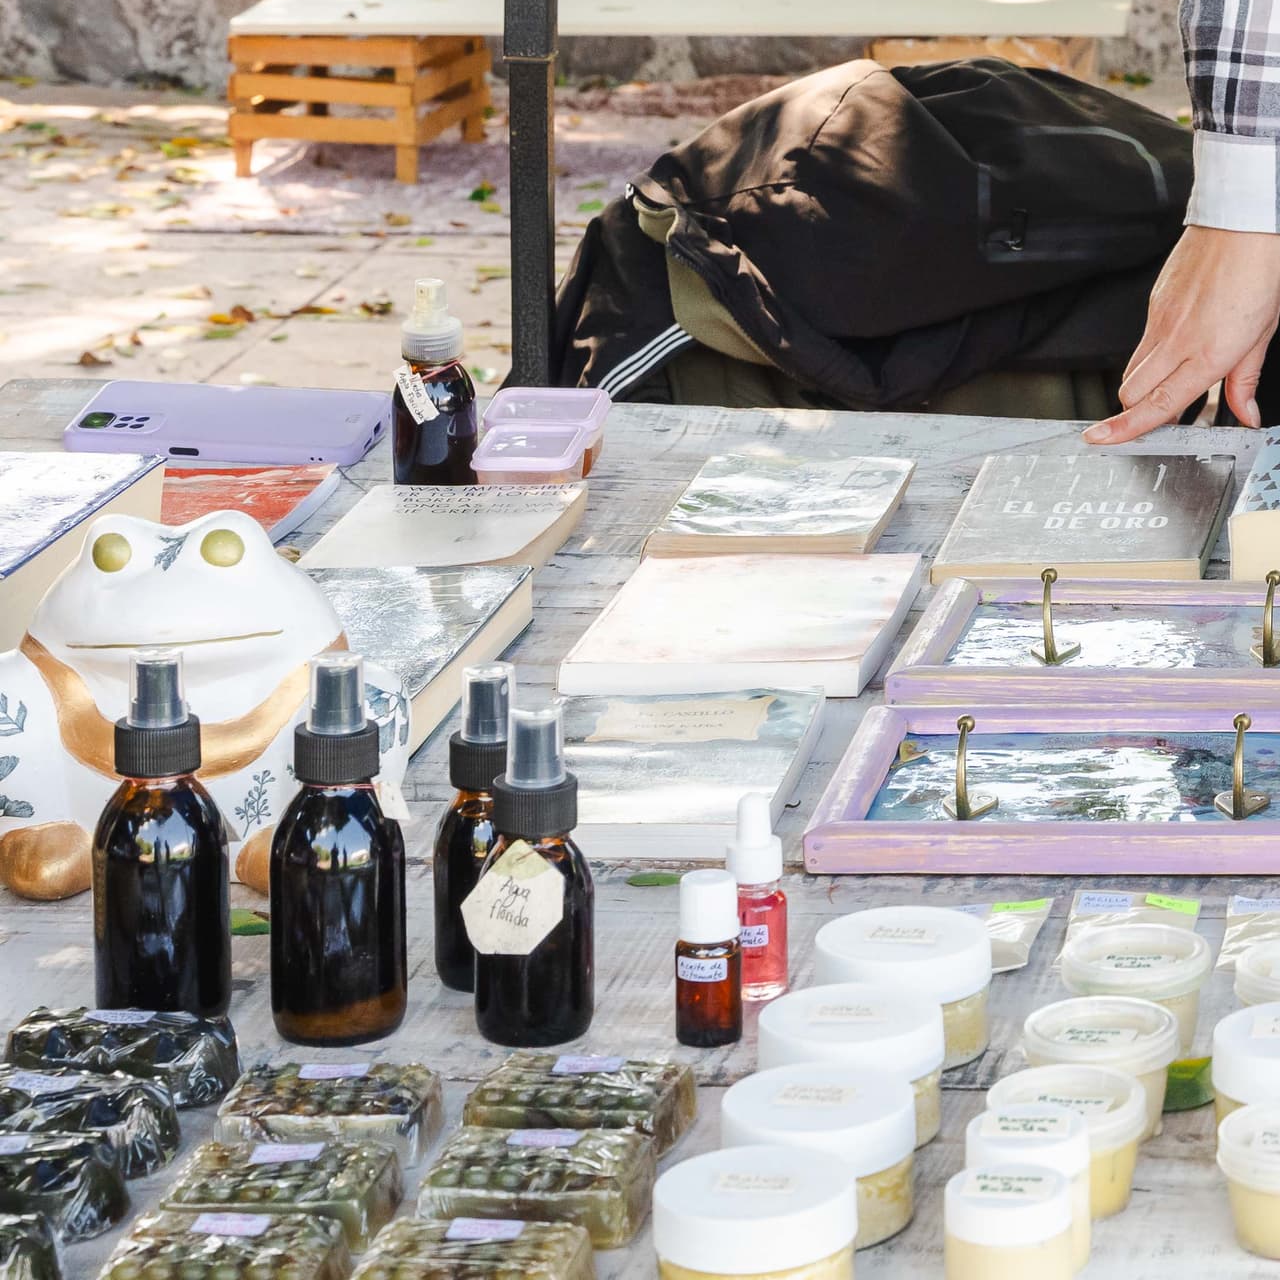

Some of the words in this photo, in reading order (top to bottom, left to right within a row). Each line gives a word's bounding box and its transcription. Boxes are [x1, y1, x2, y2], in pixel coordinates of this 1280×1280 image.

[463, 483, 579, 492] IMPOSSIBLE
[1002, 500, 1038, 514] EL
[1052, 501, 1154, 514] GALLO
[1043, 516, 1089, 530] DE
[1100, 516, 1169, 529] ORO
[499, 875, 531, 908] Agua
